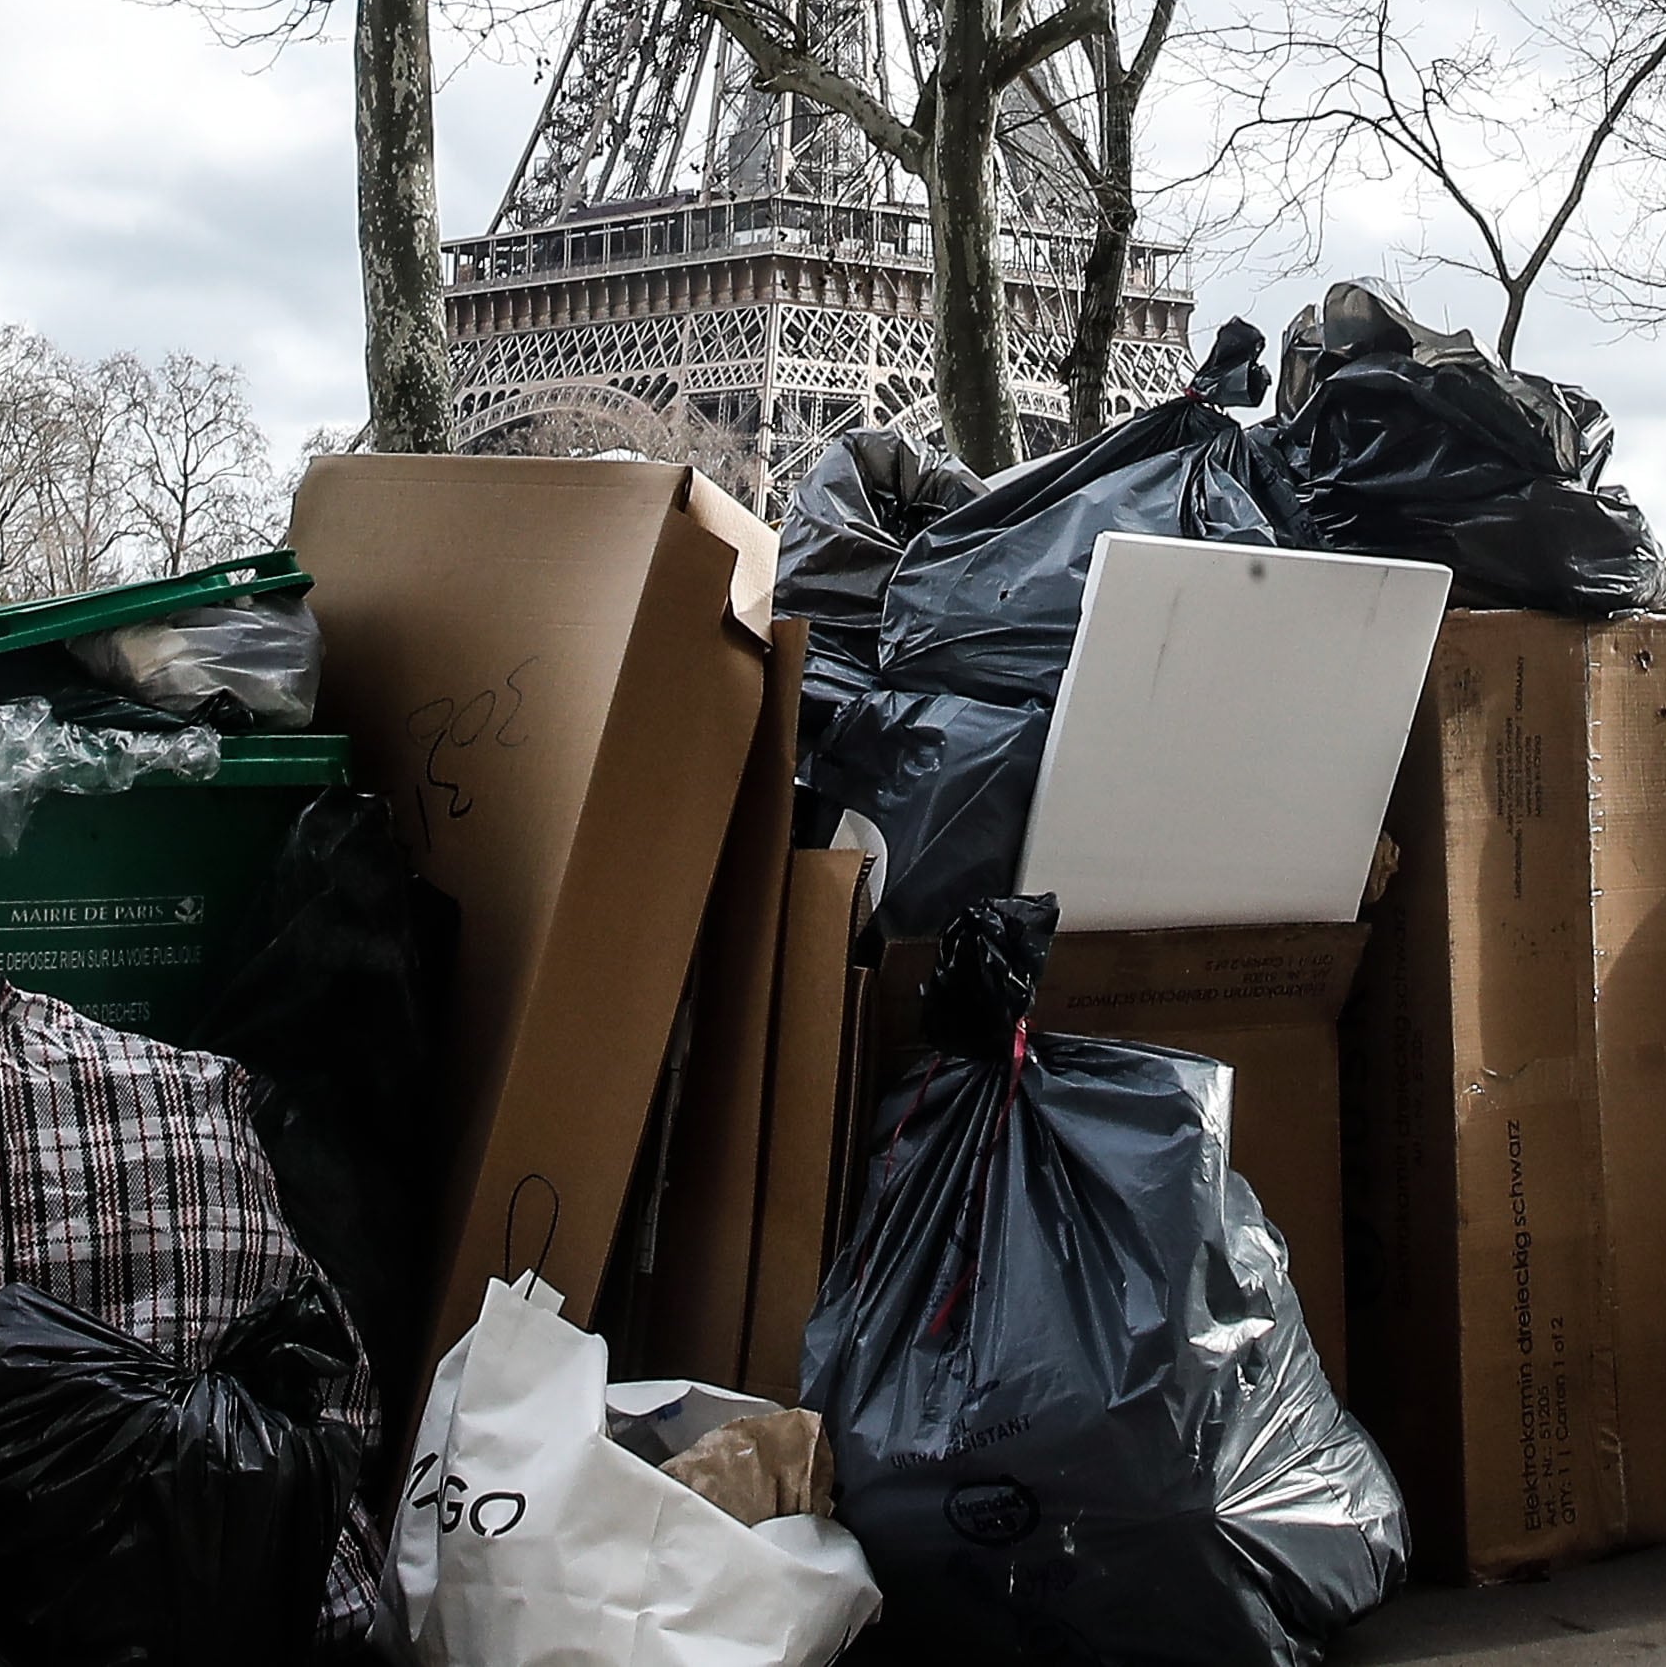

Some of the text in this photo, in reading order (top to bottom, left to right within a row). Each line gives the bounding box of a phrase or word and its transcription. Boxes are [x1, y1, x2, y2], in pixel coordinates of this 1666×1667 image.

[1515, 655, 1524, 712] GERMANY
[11, 904, 164, 924] MAIRIE DE PARIS
[7, 951, 58, 971] DEPOSEZ
[60, 950, 85, 969] RIEN
[88, 948, 110, 968] SUR
[111, 948, 126, 967] LA
[126, 947, 151, 966] VOIE
[153, 945, 205, 966] PUBLIQUE
[1388, 906, 1408, 1010] schwarz
[101, 1001, 152, 1022] DECHETS
[1068, 993, 1137, 1009] schwarz
[1505, 1119, 1542, 1531] Elektrokamin dreieckig schwarz
[1549, 1317, 1563, 1328] 2
[1550, 1332, 1565, 1354] of
[1537, 1385, 1552, 1439] 51205
[1555, 1375, 1570, 1441] Carton
[941, 1414, 1032, 1463] RESISTANT
[1544, 1496, 1557, 1526] Art.
[1560, 1480, 1576, 1524] QTY:
